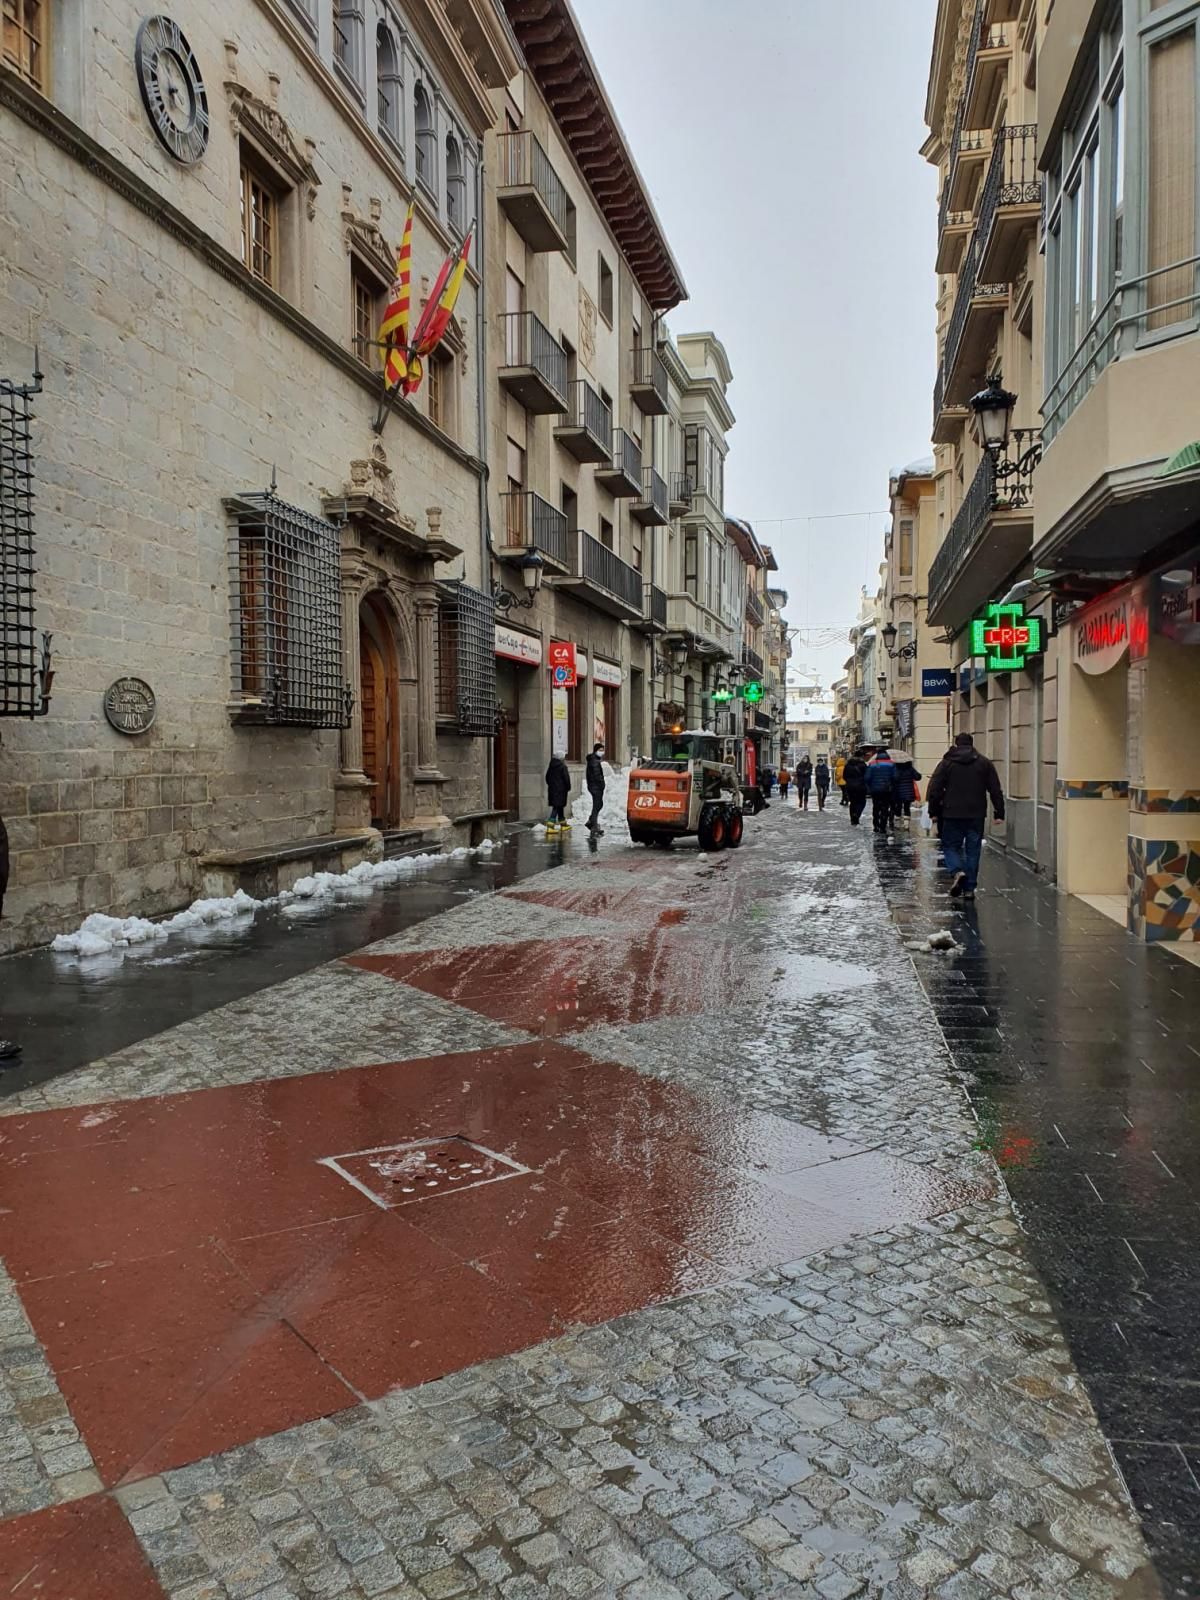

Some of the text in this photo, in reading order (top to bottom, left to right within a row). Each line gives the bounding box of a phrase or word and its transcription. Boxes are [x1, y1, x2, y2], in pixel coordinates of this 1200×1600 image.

[990, 628, 1028, 643] CRIS
[1078, 602, 1128, 658] FARMACIA
[554, 648, 569, 657] CA
[924, 679, 948, 687] BBVA
[123, 713, 143, 728] JACA
[659, 799, 681, 809] Bobcat
